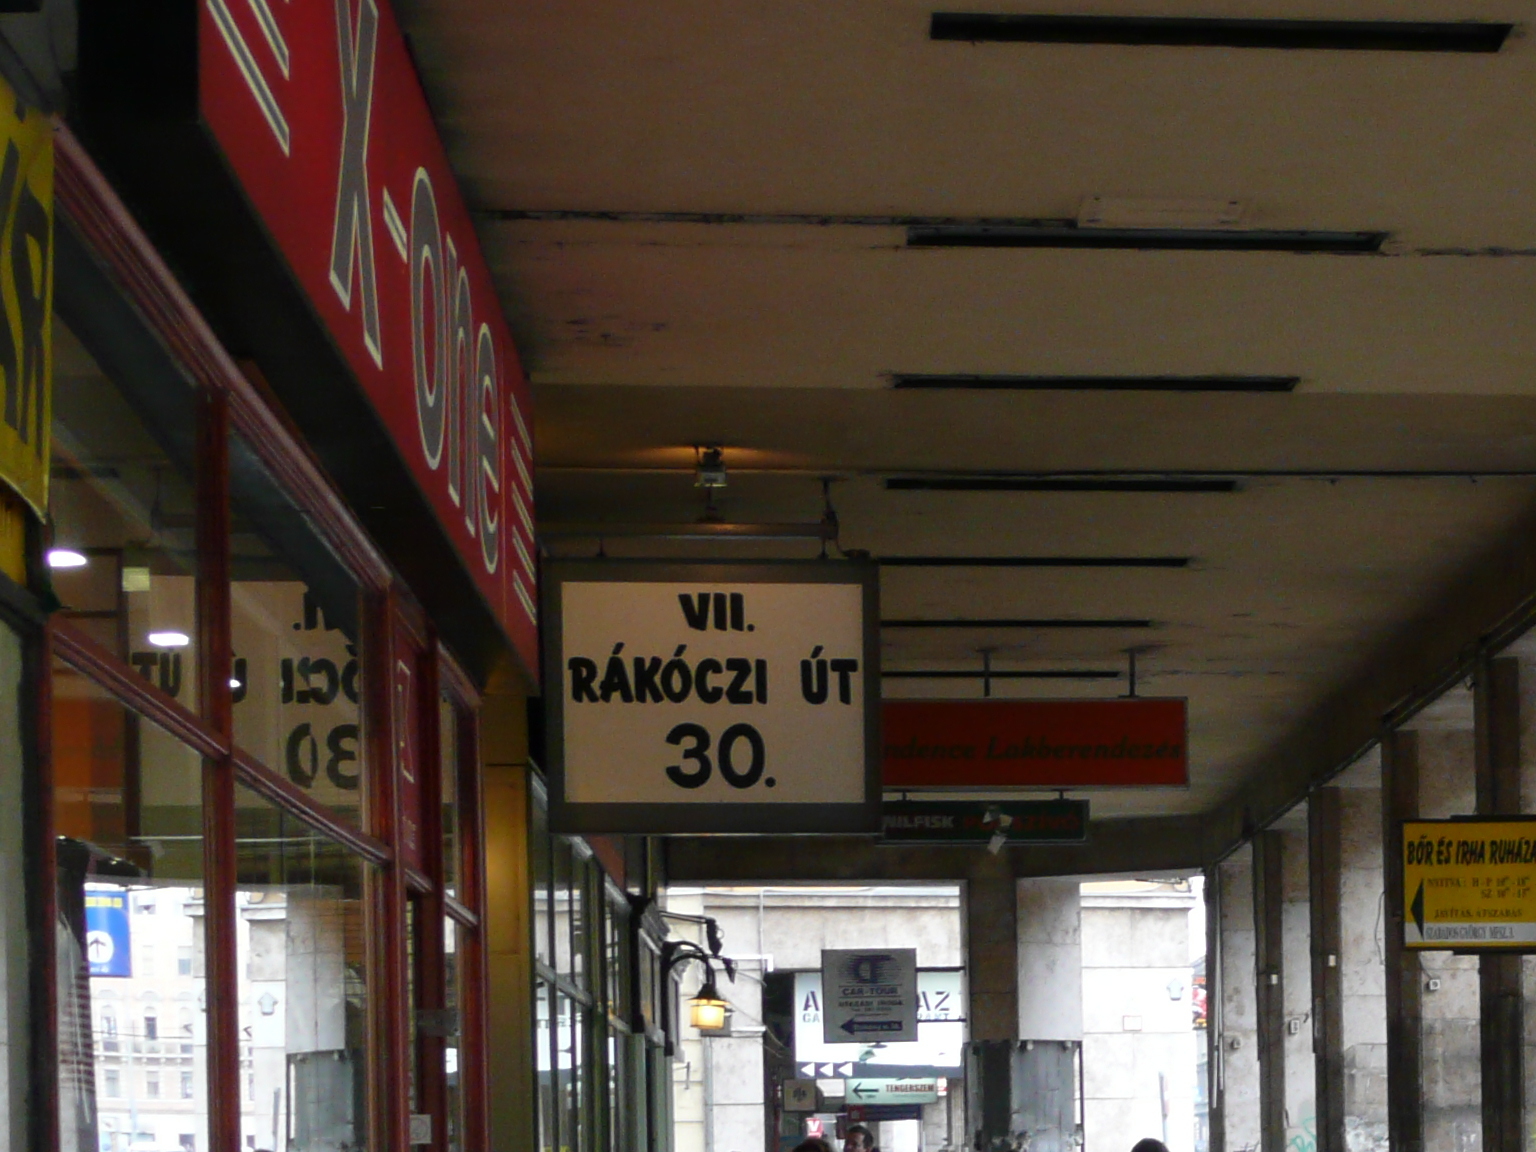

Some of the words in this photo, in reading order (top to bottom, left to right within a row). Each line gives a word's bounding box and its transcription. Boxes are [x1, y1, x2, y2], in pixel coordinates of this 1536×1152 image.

[678, 591, 756, 632] VII.
[568, 642, 768, 704] RÁKÓCZI
[801, 645, 859, 705] ÚT
[664, 722, 776, 789] 30.
[985, 734, 1180, 760] Lakberendezés
[1407, 835, 1433, 865] BŐR
[1436, 835, 1453, 865] ÉS
